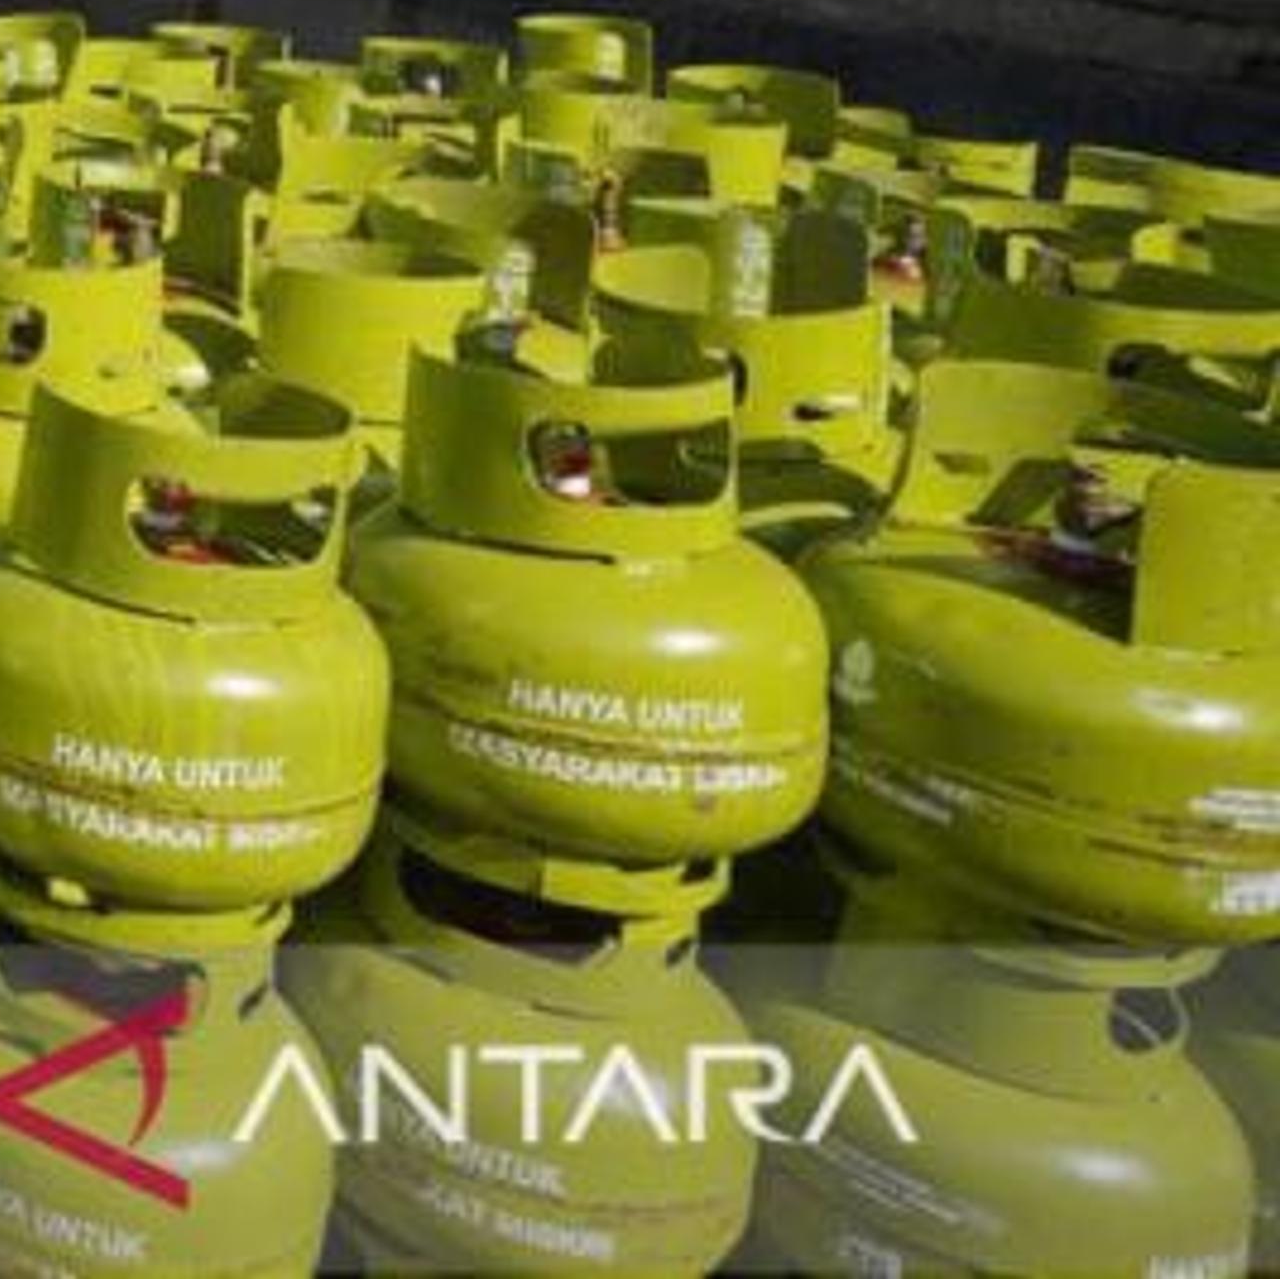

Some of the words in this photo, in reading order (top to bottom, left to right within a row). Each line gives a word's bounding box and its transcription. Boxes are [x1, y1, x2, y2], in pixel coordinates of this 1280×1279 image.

[509, 678, 629, 724] HANYA
[637, 698, 744, 733] UNTUK
[52, 731, 168, 788] HANYA
[173, 756, 287, 791] UNTUK
[444, 1139, 568, 1200] UNTUK
[35, 1211, 147, 1260] UNTUK
